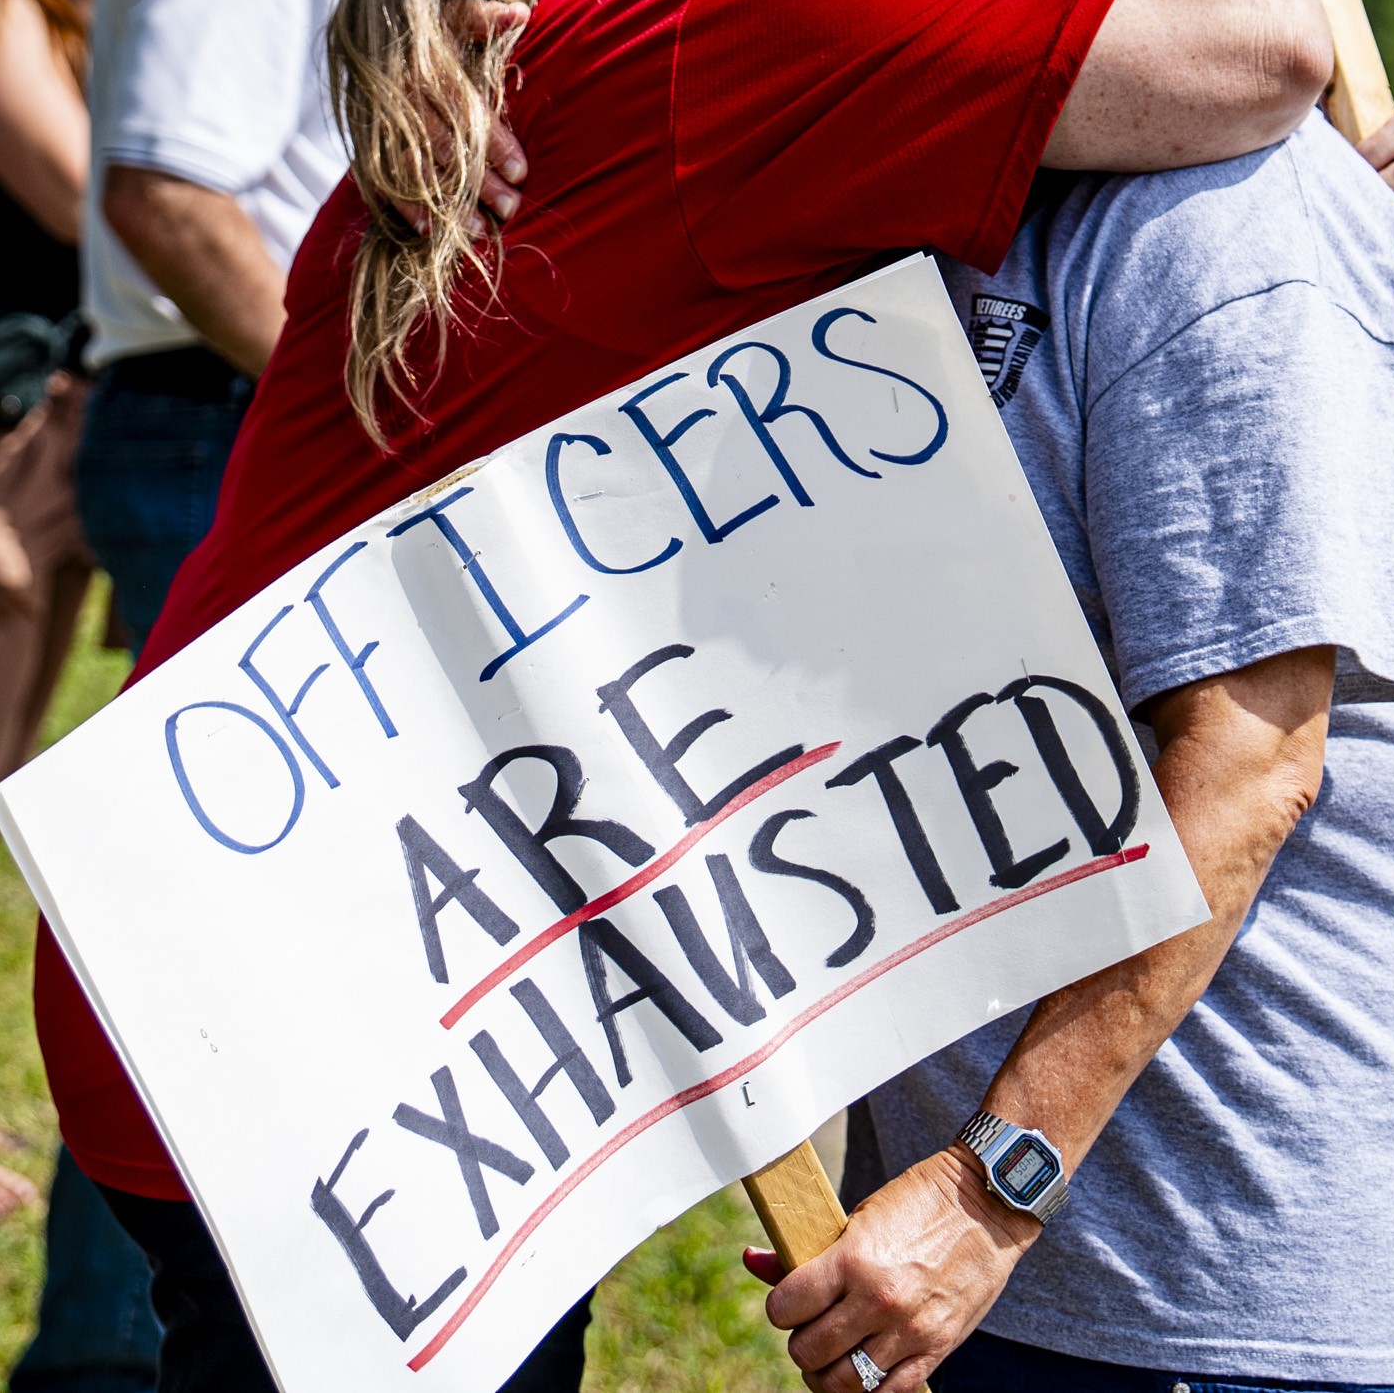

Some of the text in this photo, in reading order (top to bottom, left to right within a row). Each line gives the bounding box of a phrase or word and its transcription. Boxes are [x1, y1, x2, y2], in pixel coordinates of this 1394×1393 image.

[165, 306, 949, 854] OFFICERS
[397, 644, 805, 984] ARE
[309, 675, 1144, 1341] EXHAUSTED
